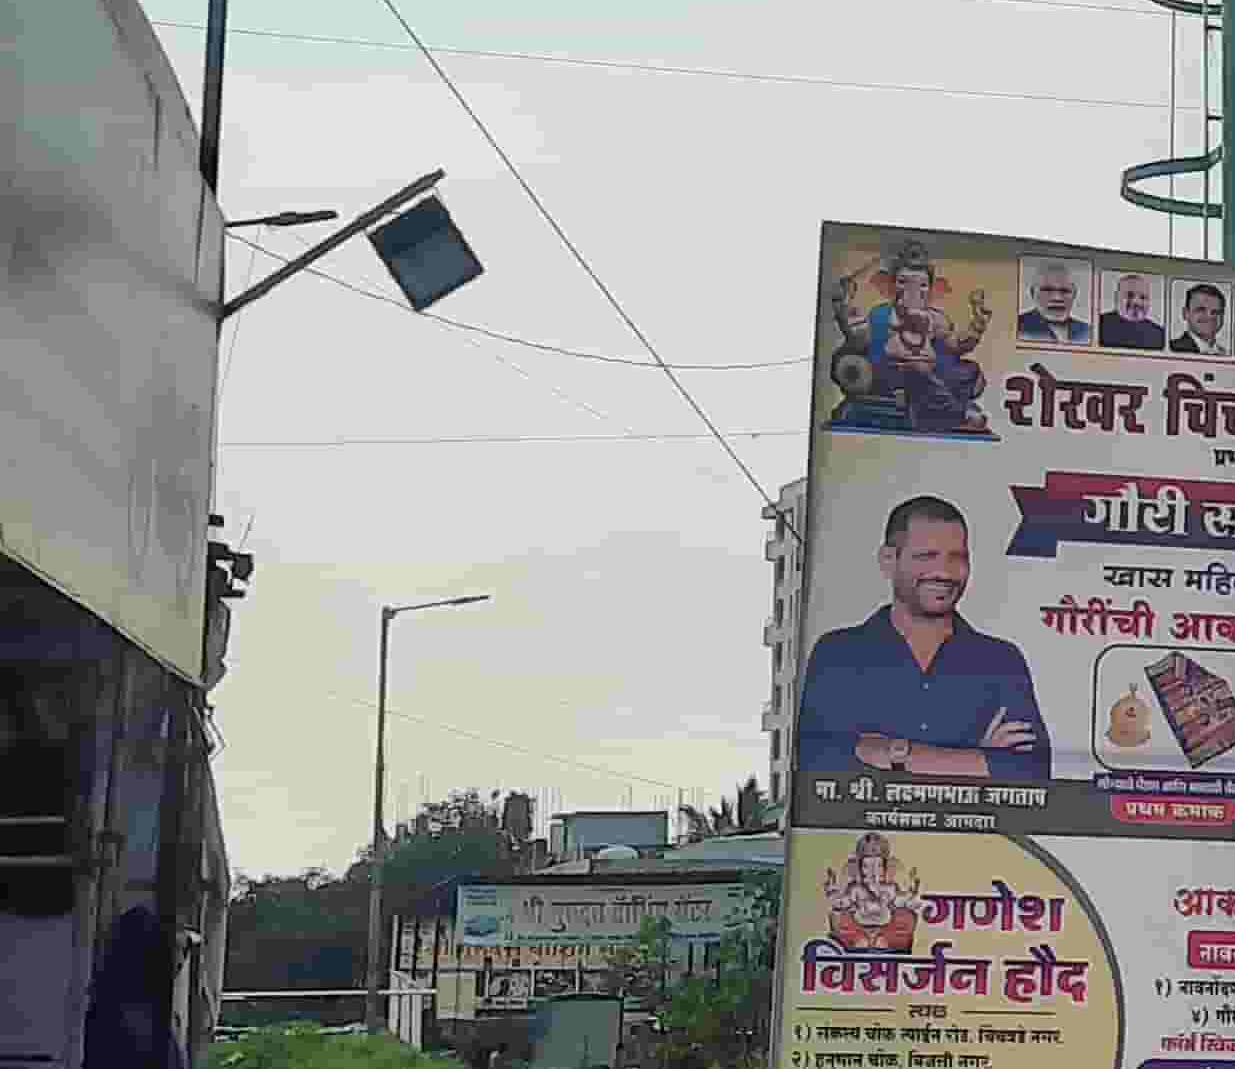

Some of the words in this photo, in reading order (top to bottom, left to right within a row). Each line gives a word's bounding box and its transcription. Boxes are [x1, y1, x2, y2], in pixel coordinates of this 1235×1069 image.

[1004, 362, 1148, 433] शेखर
[1082, 482, 1190, 536] गौरी
[1103, 565, 1174, 588] खास
[1040, 594, 1156, 637] गौरींची
[920, 881, 1065, 932] गणेश
[800, 939, 993, 997] विसर्जन
[1003, 944, 1090, 1005] हौद
